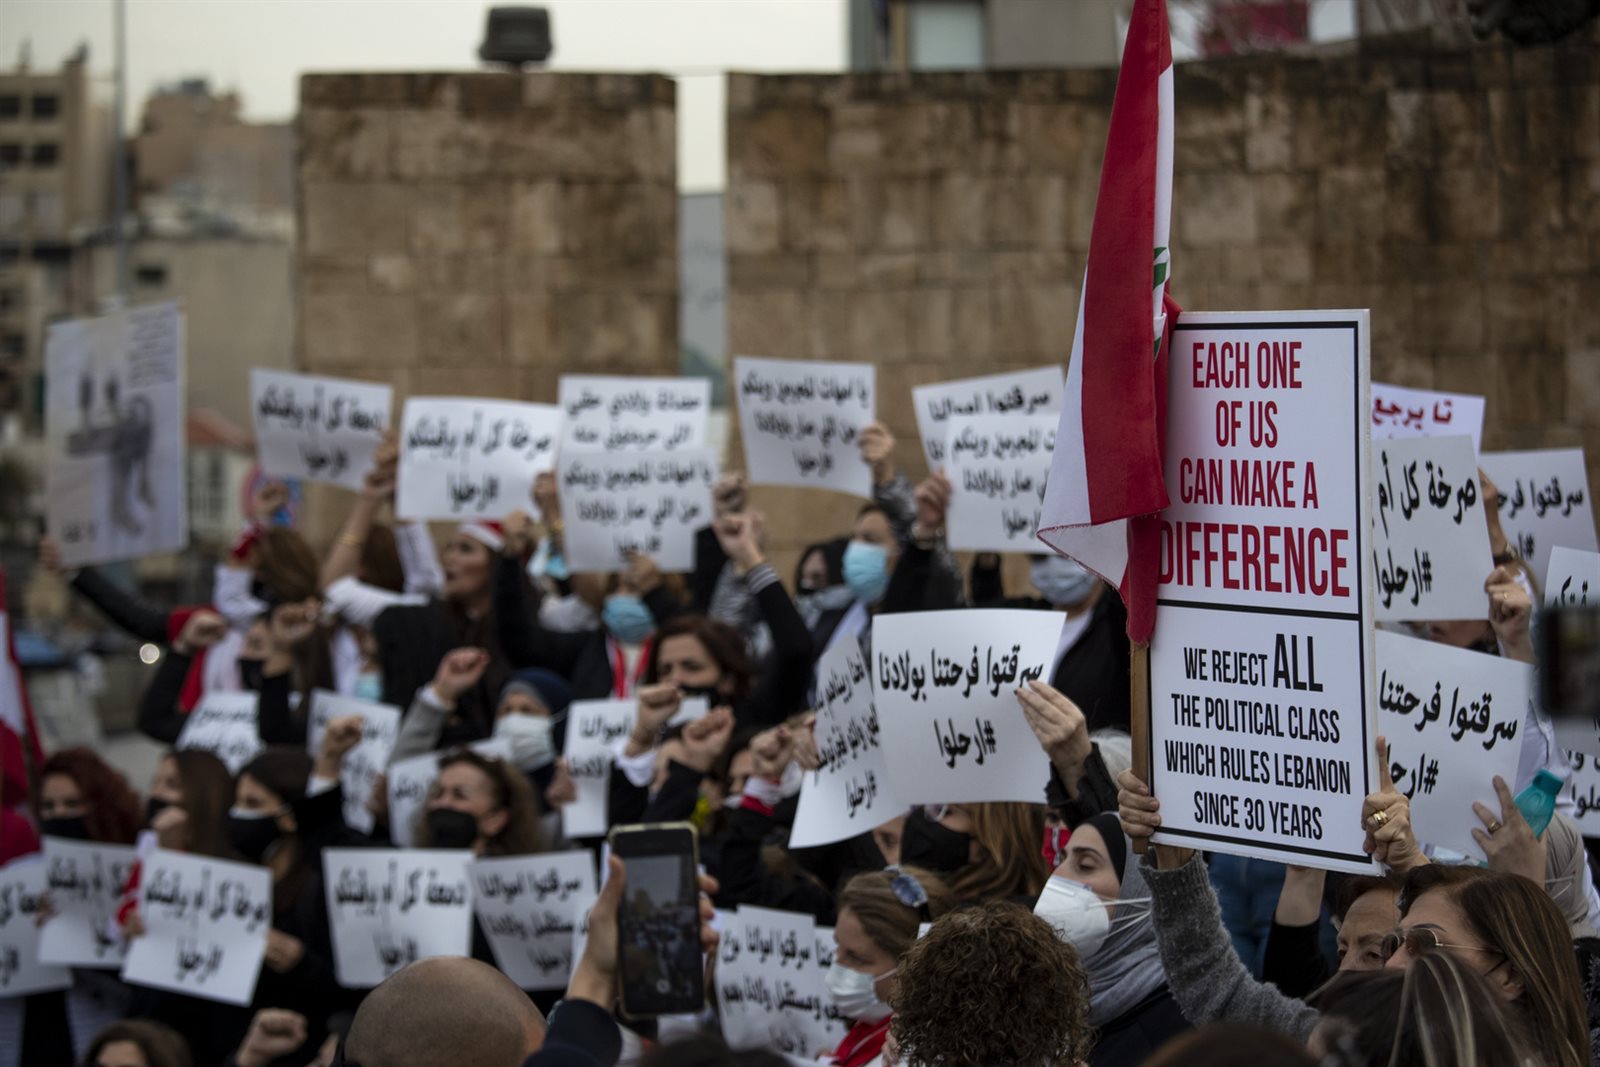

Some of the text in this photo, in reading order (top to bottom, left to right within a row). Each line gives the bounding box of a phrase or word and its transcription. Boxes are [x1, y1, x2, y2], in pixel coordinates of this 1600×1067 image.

[1193, 341, 1302, 389] EACH ONE
[1216, 400, 1278, 448] OF US
[1180, 457, 1319, 509] CAN MAKE A
[1378, 450, 1477, 540] صرخة كل أم
[1158, 520, 1350, 597] DIFFERENCE
[1373, 547, 1432, 610] #ارحلوا
[878, 644, 1044, 702] سرقتوا فرحتنا بولادنا
[1184, 633, 1324, 692] WE REJECT ALL
[1171, 693, 1340, 744] THE POLITICAL CLASS
[1378, 669, 1442, 732] فرحتنا
[1449, 686, 1518, 751] سرقتوا
[934, 717, 997, 769] #ارحلوا
[1164, 739, 1351, 795] WHICH RULES LEBANON
[1194, 790, 1323, 841] SINCE 30 YEARS
